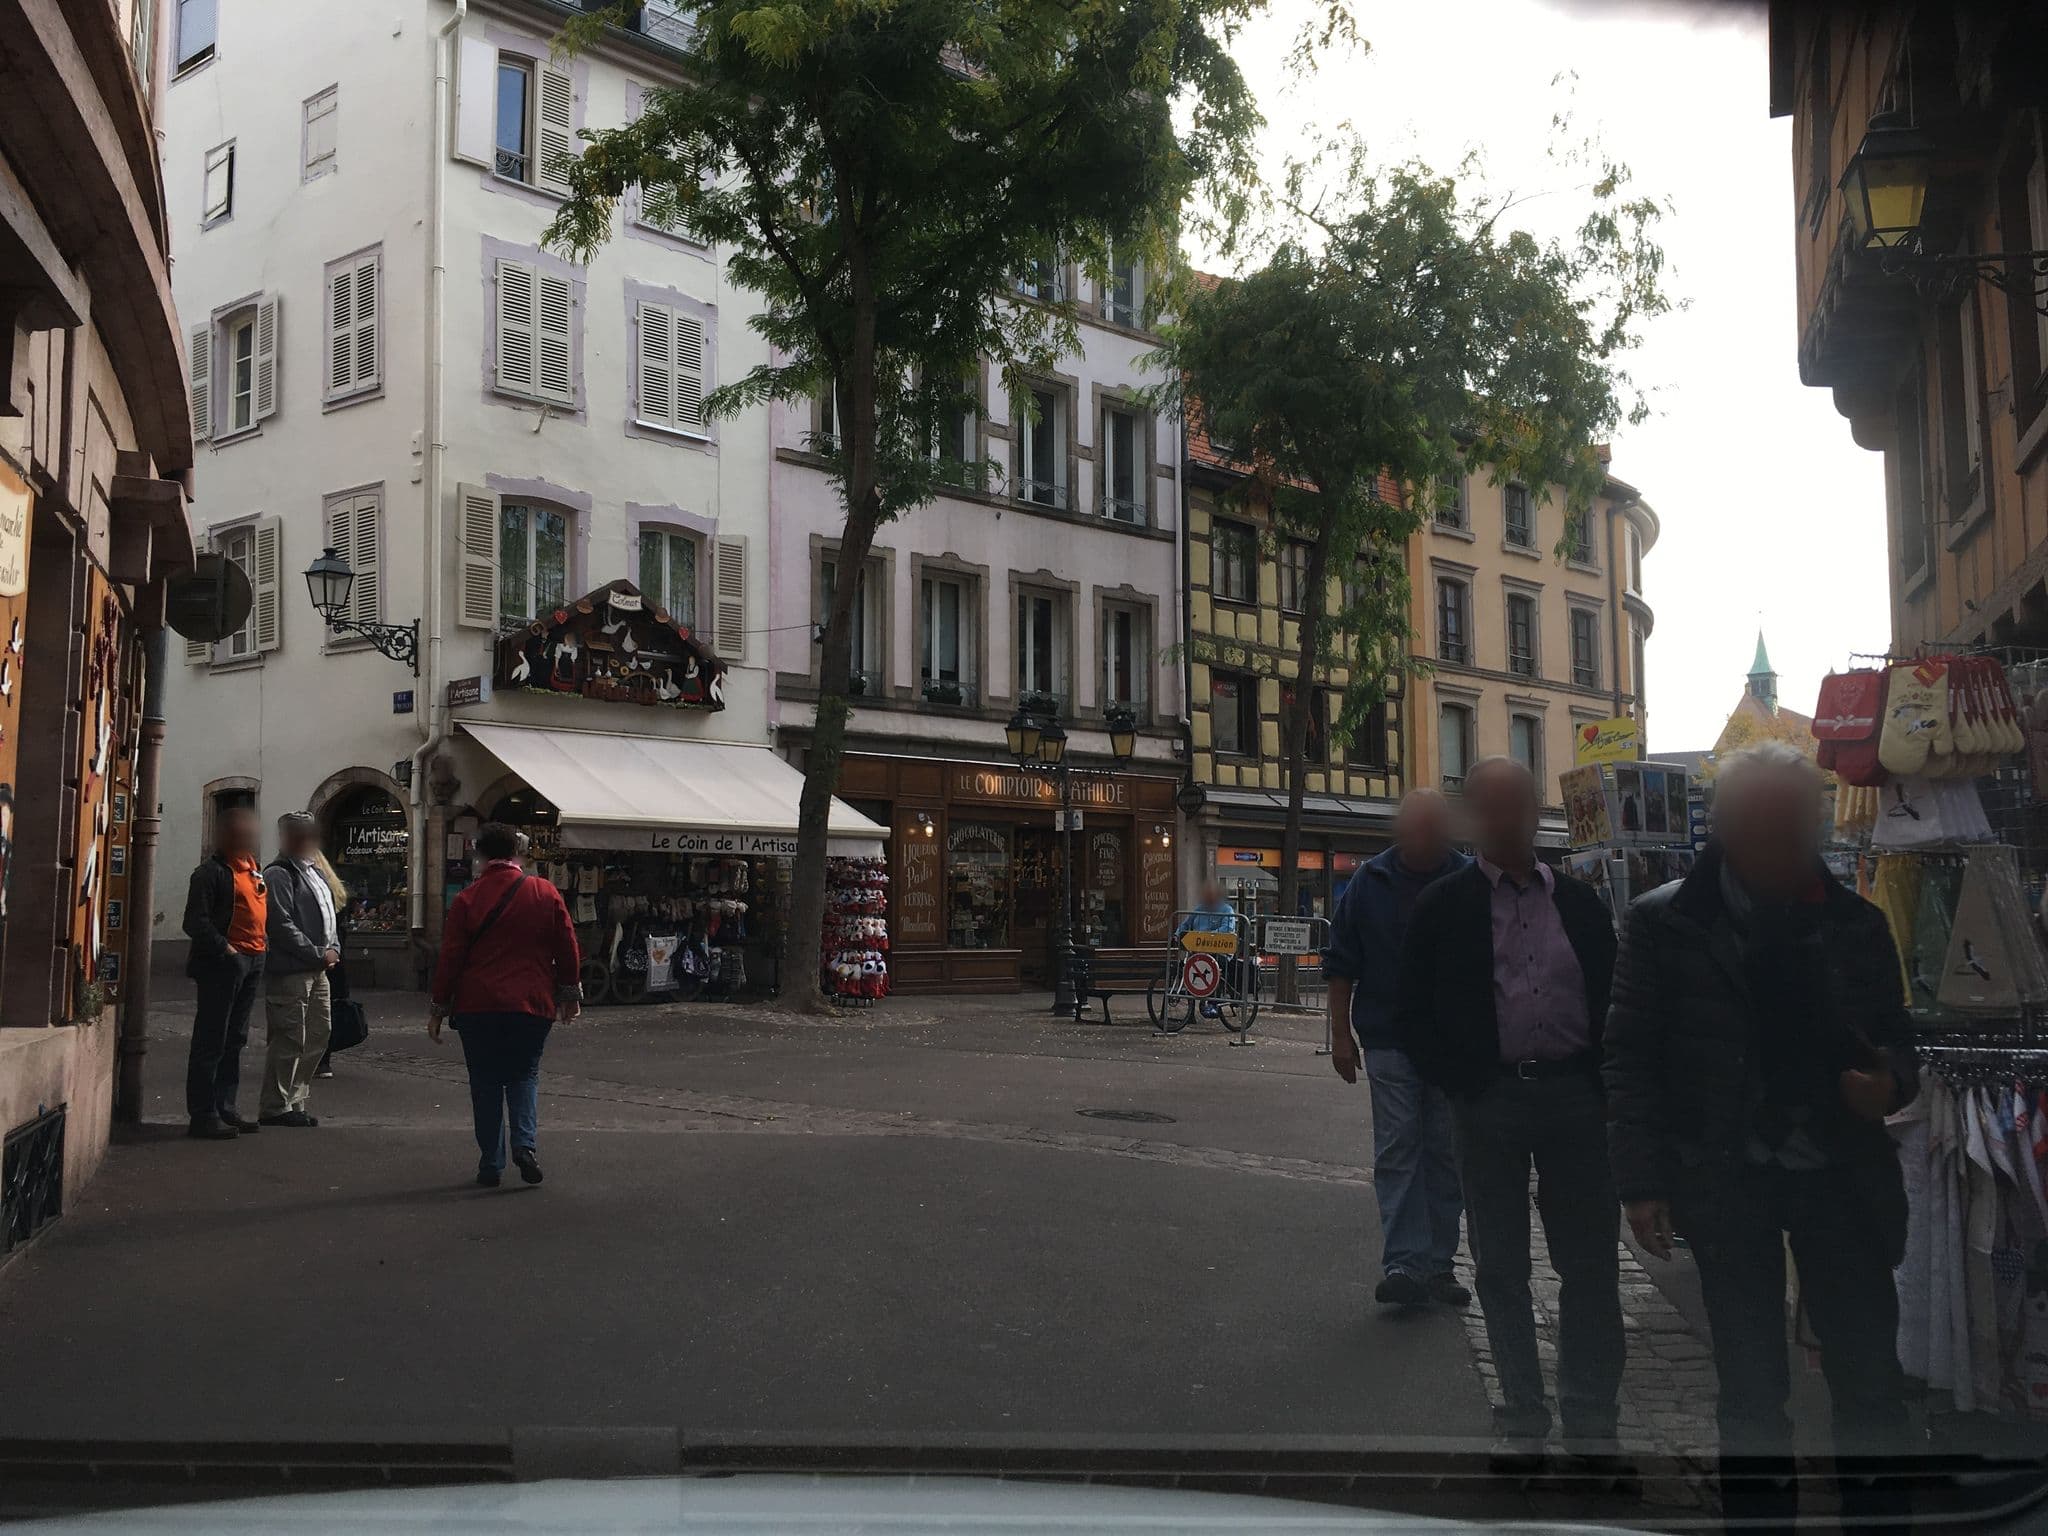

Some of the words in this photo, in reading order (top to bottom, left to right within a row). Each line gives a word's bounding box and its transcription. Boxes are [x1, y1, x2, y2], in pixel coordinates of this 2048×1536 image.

[960, 775, 970, 790] LE
[975, 773, 1042, 798] COMPTOIR
[652, 833, 669, 848] Le
[678, 835, 708, 849] Coin
[715, 836, 732, 850] de
[1196, 937, 1234, 949] Déviation
